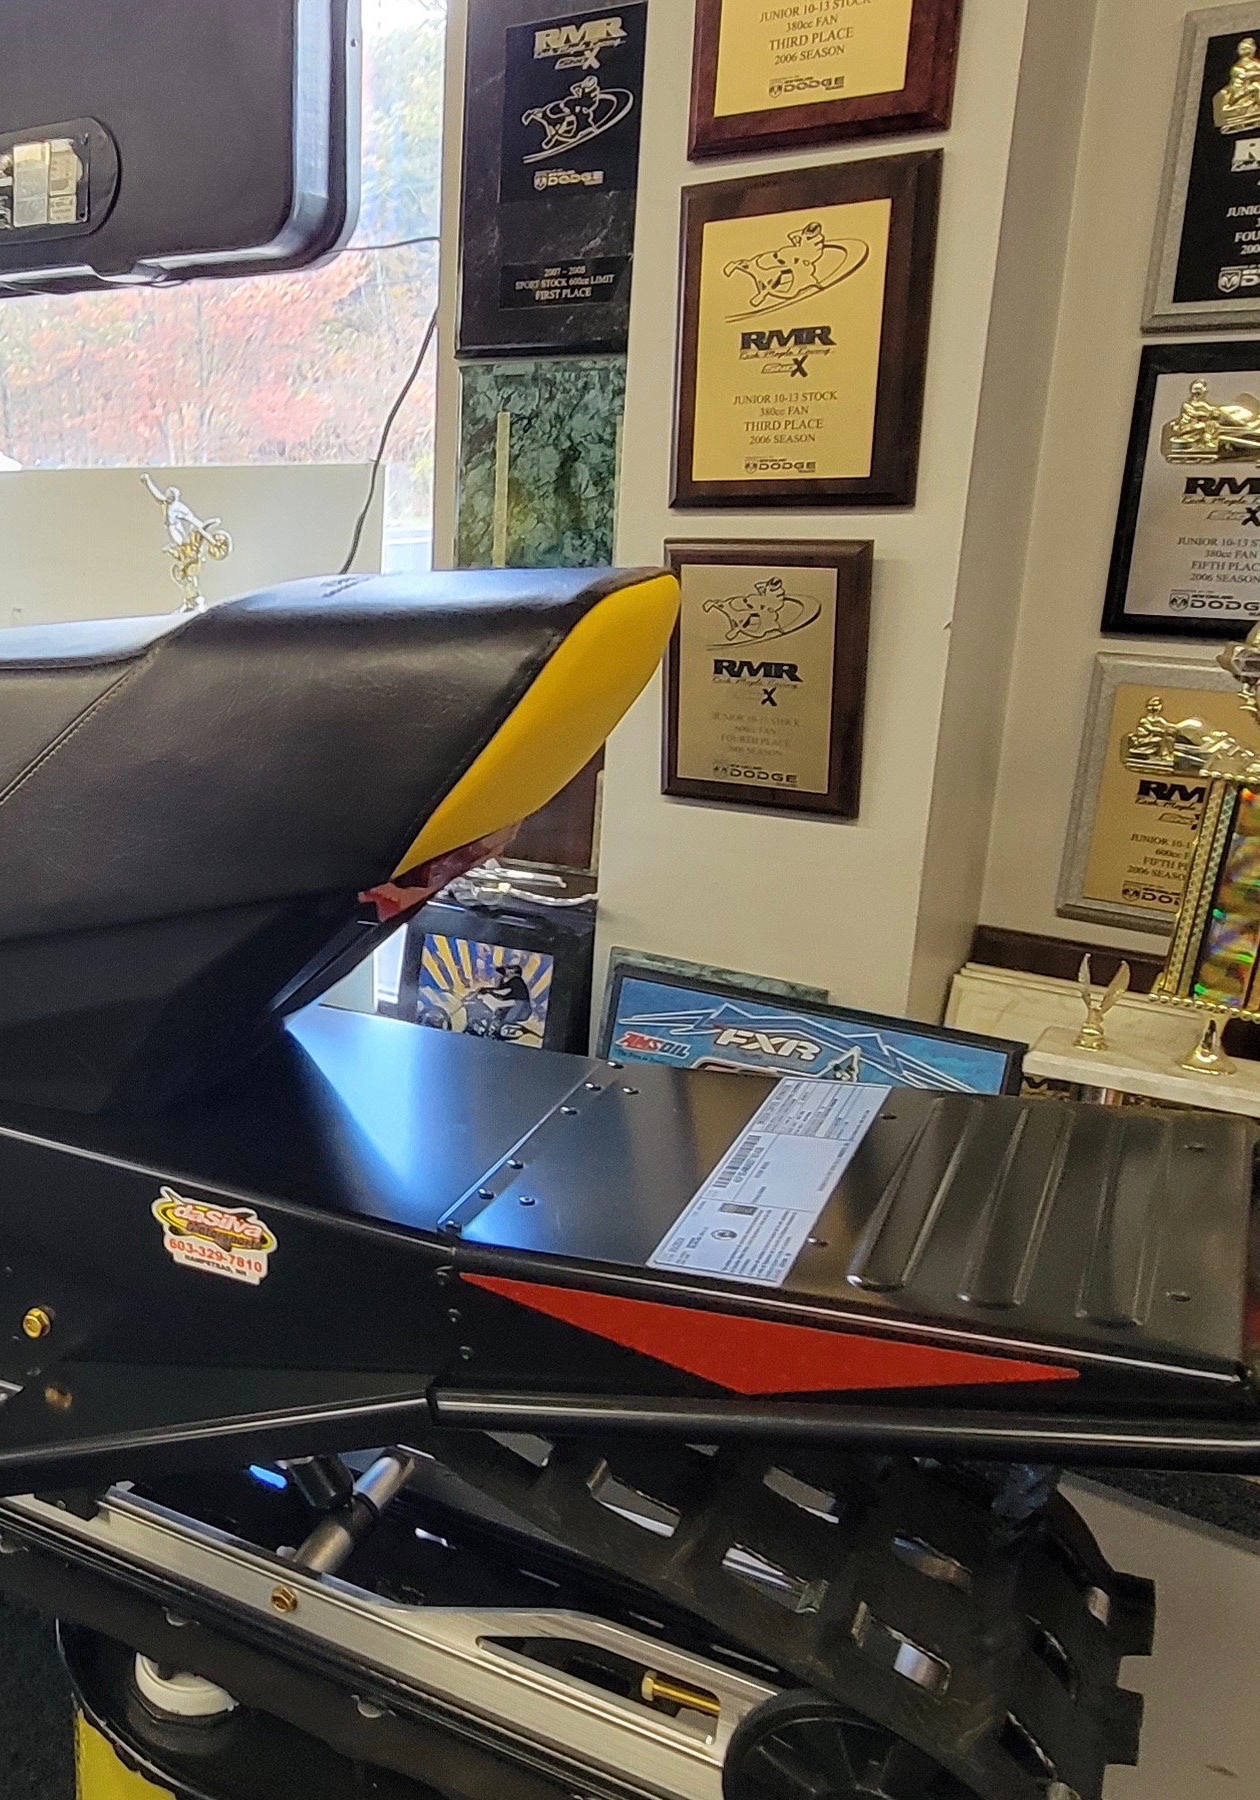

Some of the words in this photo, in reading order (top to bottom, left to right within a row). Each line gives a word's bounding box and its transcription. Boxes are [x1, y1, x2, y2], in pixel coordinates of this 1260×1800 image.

[759, 6, 800, 22] JUNIOR
[803, 1, 830, 14] 10-13
[786, 20, 813, 32] 380cc
[815, 14, 839, 27] FAN
[535, 17, 628, 50] RMR
[769, 34, 809, 51] THIRD
[811, 27, 854, 44] PLACE
[774, 53, 798, 65] 2006
[800, 45, 845, 60] SEASON
[784, 76, 844, 93] DODGE
[1227, 205, 1260, 217] JUNIO
[541, 278, 568, 288] STOCK
[590, 274, 615, 284] LIMIT
[535, 289, 561, 301] FIRST
[562, 287, 592, 299] PLACE
[740, 326, 837, 351] RMR
[733, 394, 772, 405] JUNIOR
[774, 393, 799, 404] 10-13
[801, 391, 837, 402] STOCK
[760, 407, 785, 417] 380cc
[788, 406, 809, 415] FAN
[744, 420, 781, 432] THIRD
[783, 418, 824, 430] PLACE
[749, 435, 772, 445] 2006
[773, 433, 816, 444] SEASON
[759, 461, 816, 471] DODGE
[1184, 477, 1260, 496] RM
[1178, 537, 1218, 546] JUNIOR
[1222, 538, 1248, 547] 10-13
[1235, 550, 1258, 558] FAN
[1191, 561, 1226, 570] FIFTH
[1228, 562, 1260, 572] PLAC
[1190, 573, 1213, 581] 2006
[1190, 599, 1260, 612] DODG
[713, 659, 803, 682] RMR
[730, 768, 797, 783] DODGE
[1130, 833, 1168, 845] JUNIOR
[1171, 839, 1192, 849] 10-1
[1143, 856, 1175, 869] FIFTH
[1127, 865, 1149, 875] 2006
[1151, 868, 1186, 880] SEASO
[618, 1031, 692, 1059] AMSOIL
[714, 1028, 822, 1062] FXR
[169, 1238, 262, 1273] 603-329-7810
